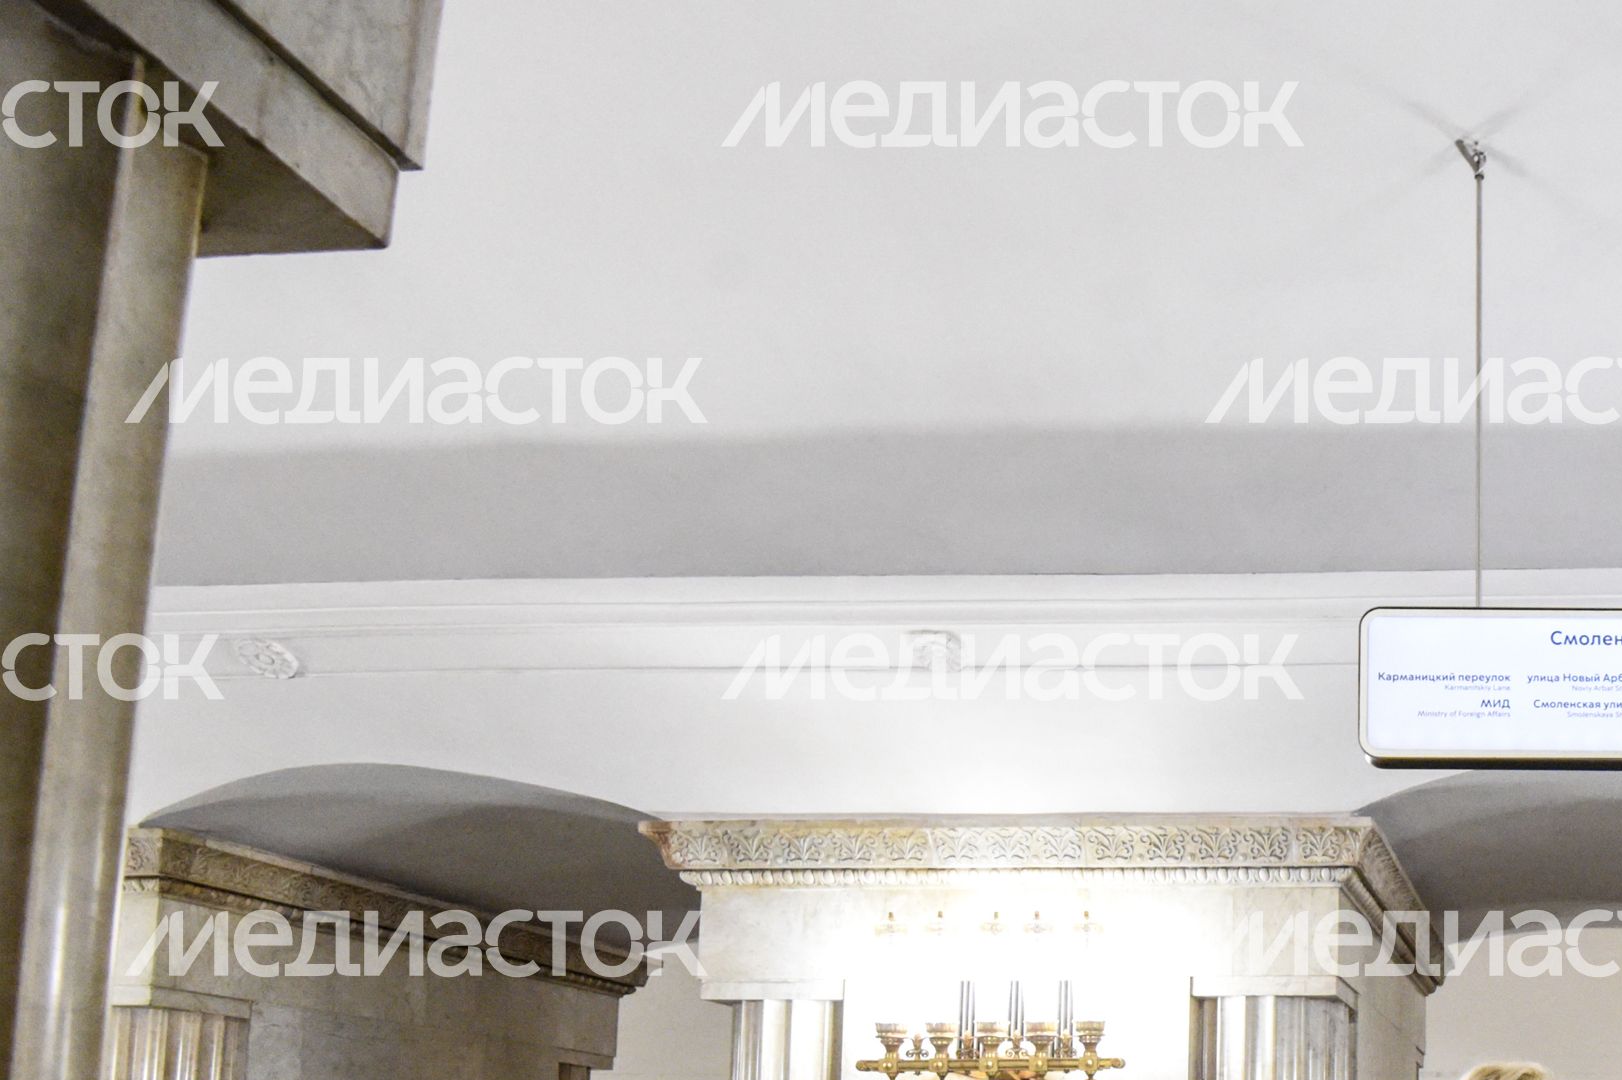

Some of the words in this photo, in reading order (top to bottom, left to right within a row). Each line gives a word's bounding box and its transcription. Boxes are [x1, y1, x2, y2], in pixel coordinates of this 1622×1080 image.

[1378, 672, 1456, 683] Карманицкий
[1458, 674, 1511, 685] переулок
[1527, 675, 1561, 685] улица
[1563, 674, 1600, 682] Новый
[1481, 699, 1510, 709] МИД
[1534, 700, 1601, 708] Смоленская
